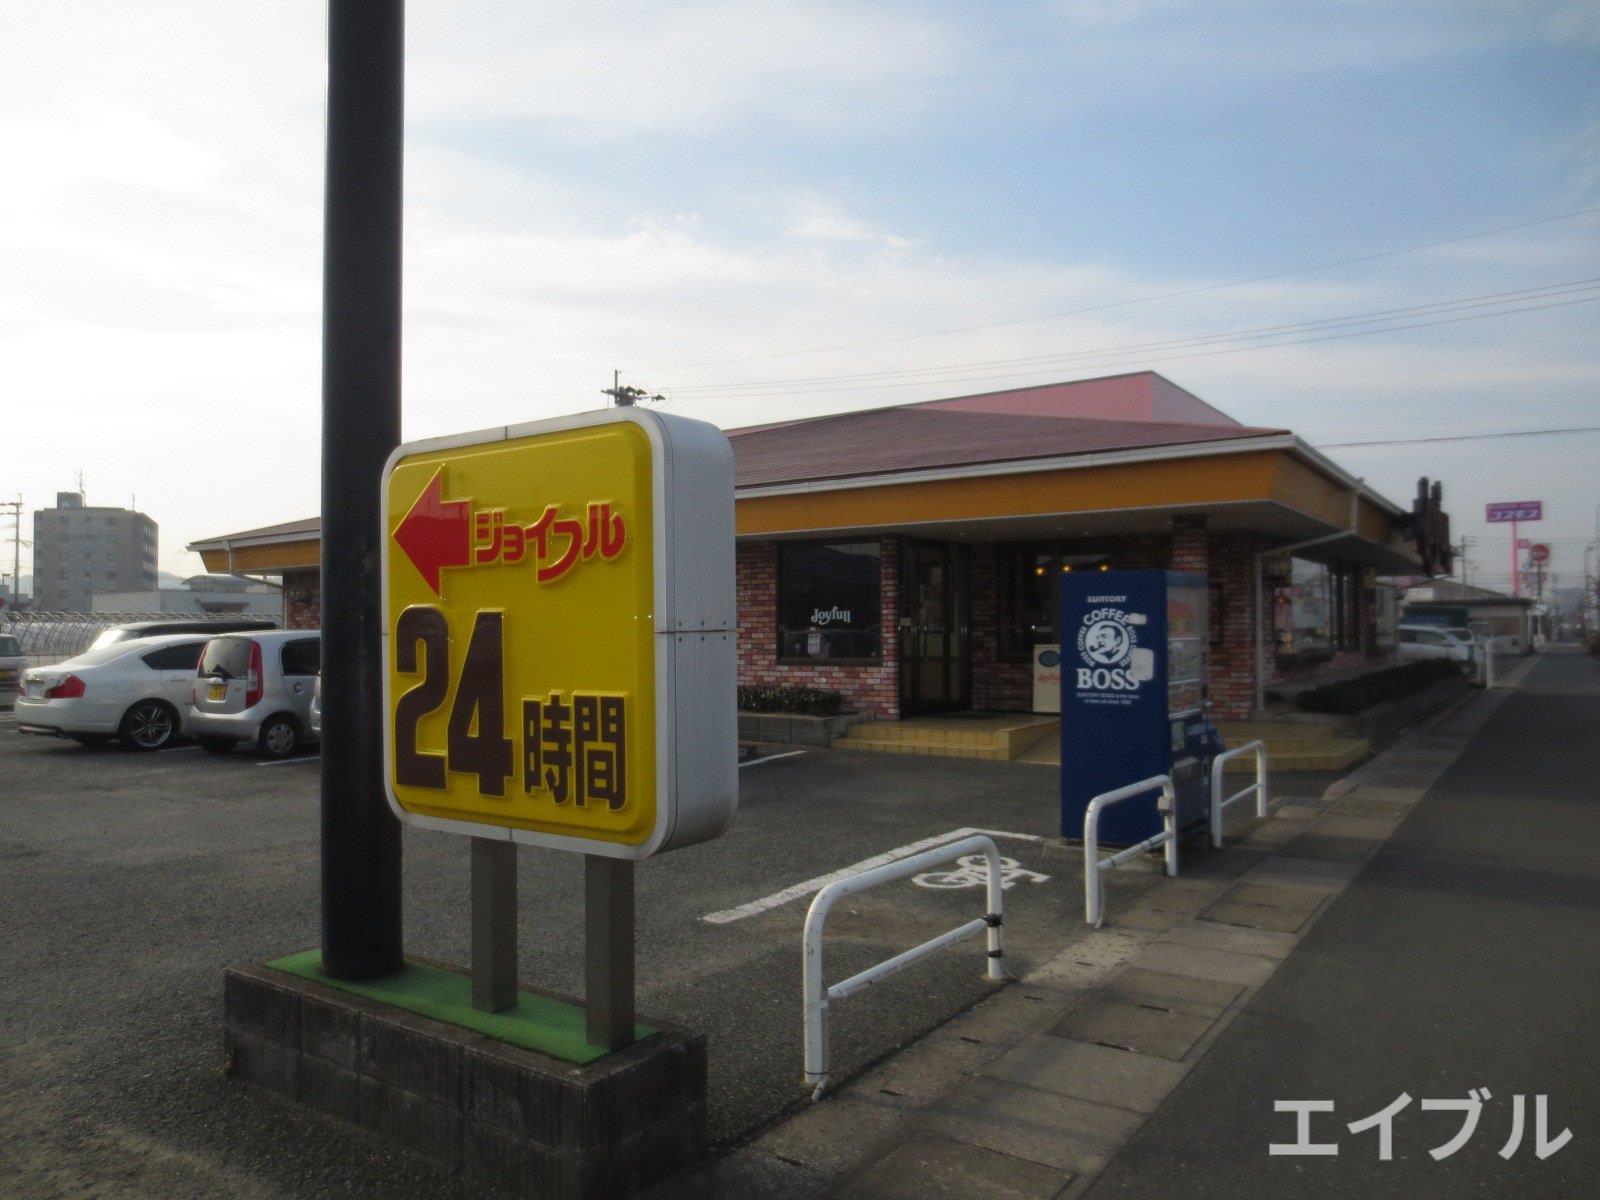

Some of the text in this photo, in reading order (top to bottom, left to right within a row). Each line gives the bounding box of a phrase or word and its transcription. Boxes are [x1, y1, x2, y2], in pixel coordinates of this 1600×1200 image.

[475, 502, 626, 583] ジョイフル
[811, 605, 851, 626] Joyfull
[1077, 668, 1140, 690] BOSS
[395, 604, 628, 810] 24時間
